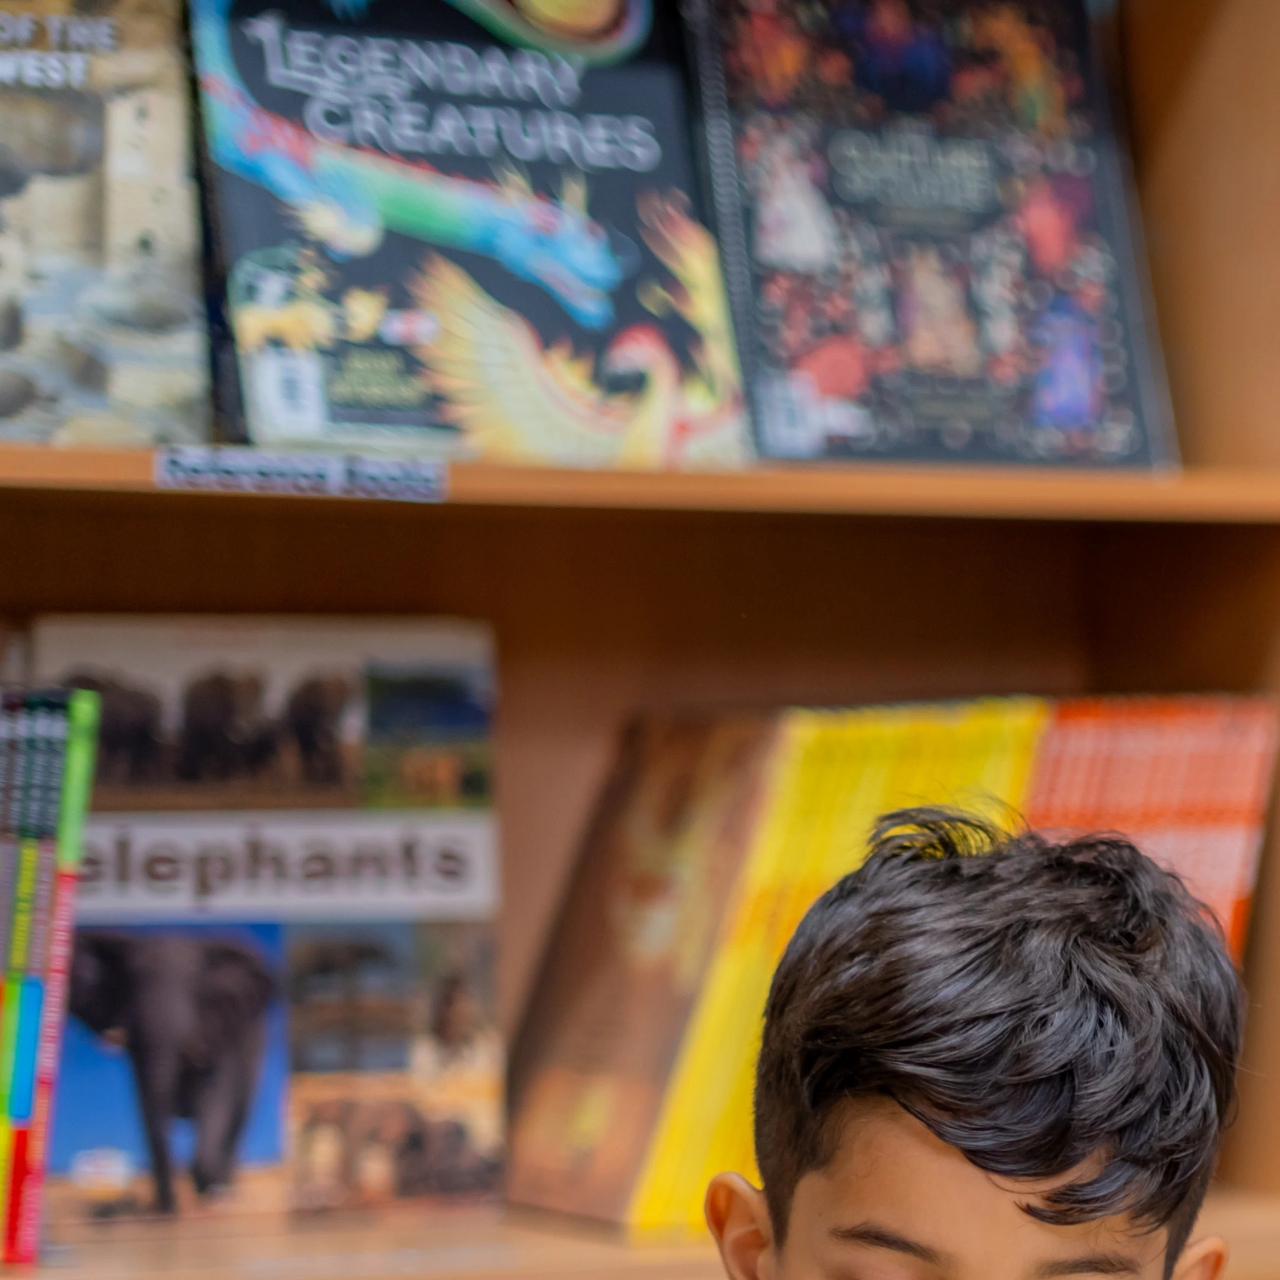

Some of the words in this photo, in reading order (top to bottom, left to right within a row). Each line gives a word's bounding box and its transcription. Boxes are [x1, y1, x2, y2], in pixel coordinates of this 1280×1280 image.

[45, 13, 118, 51] THE
[243, 14, 585, 108] LEGENDARY
[303, 100, 664, 174] CREATURES
